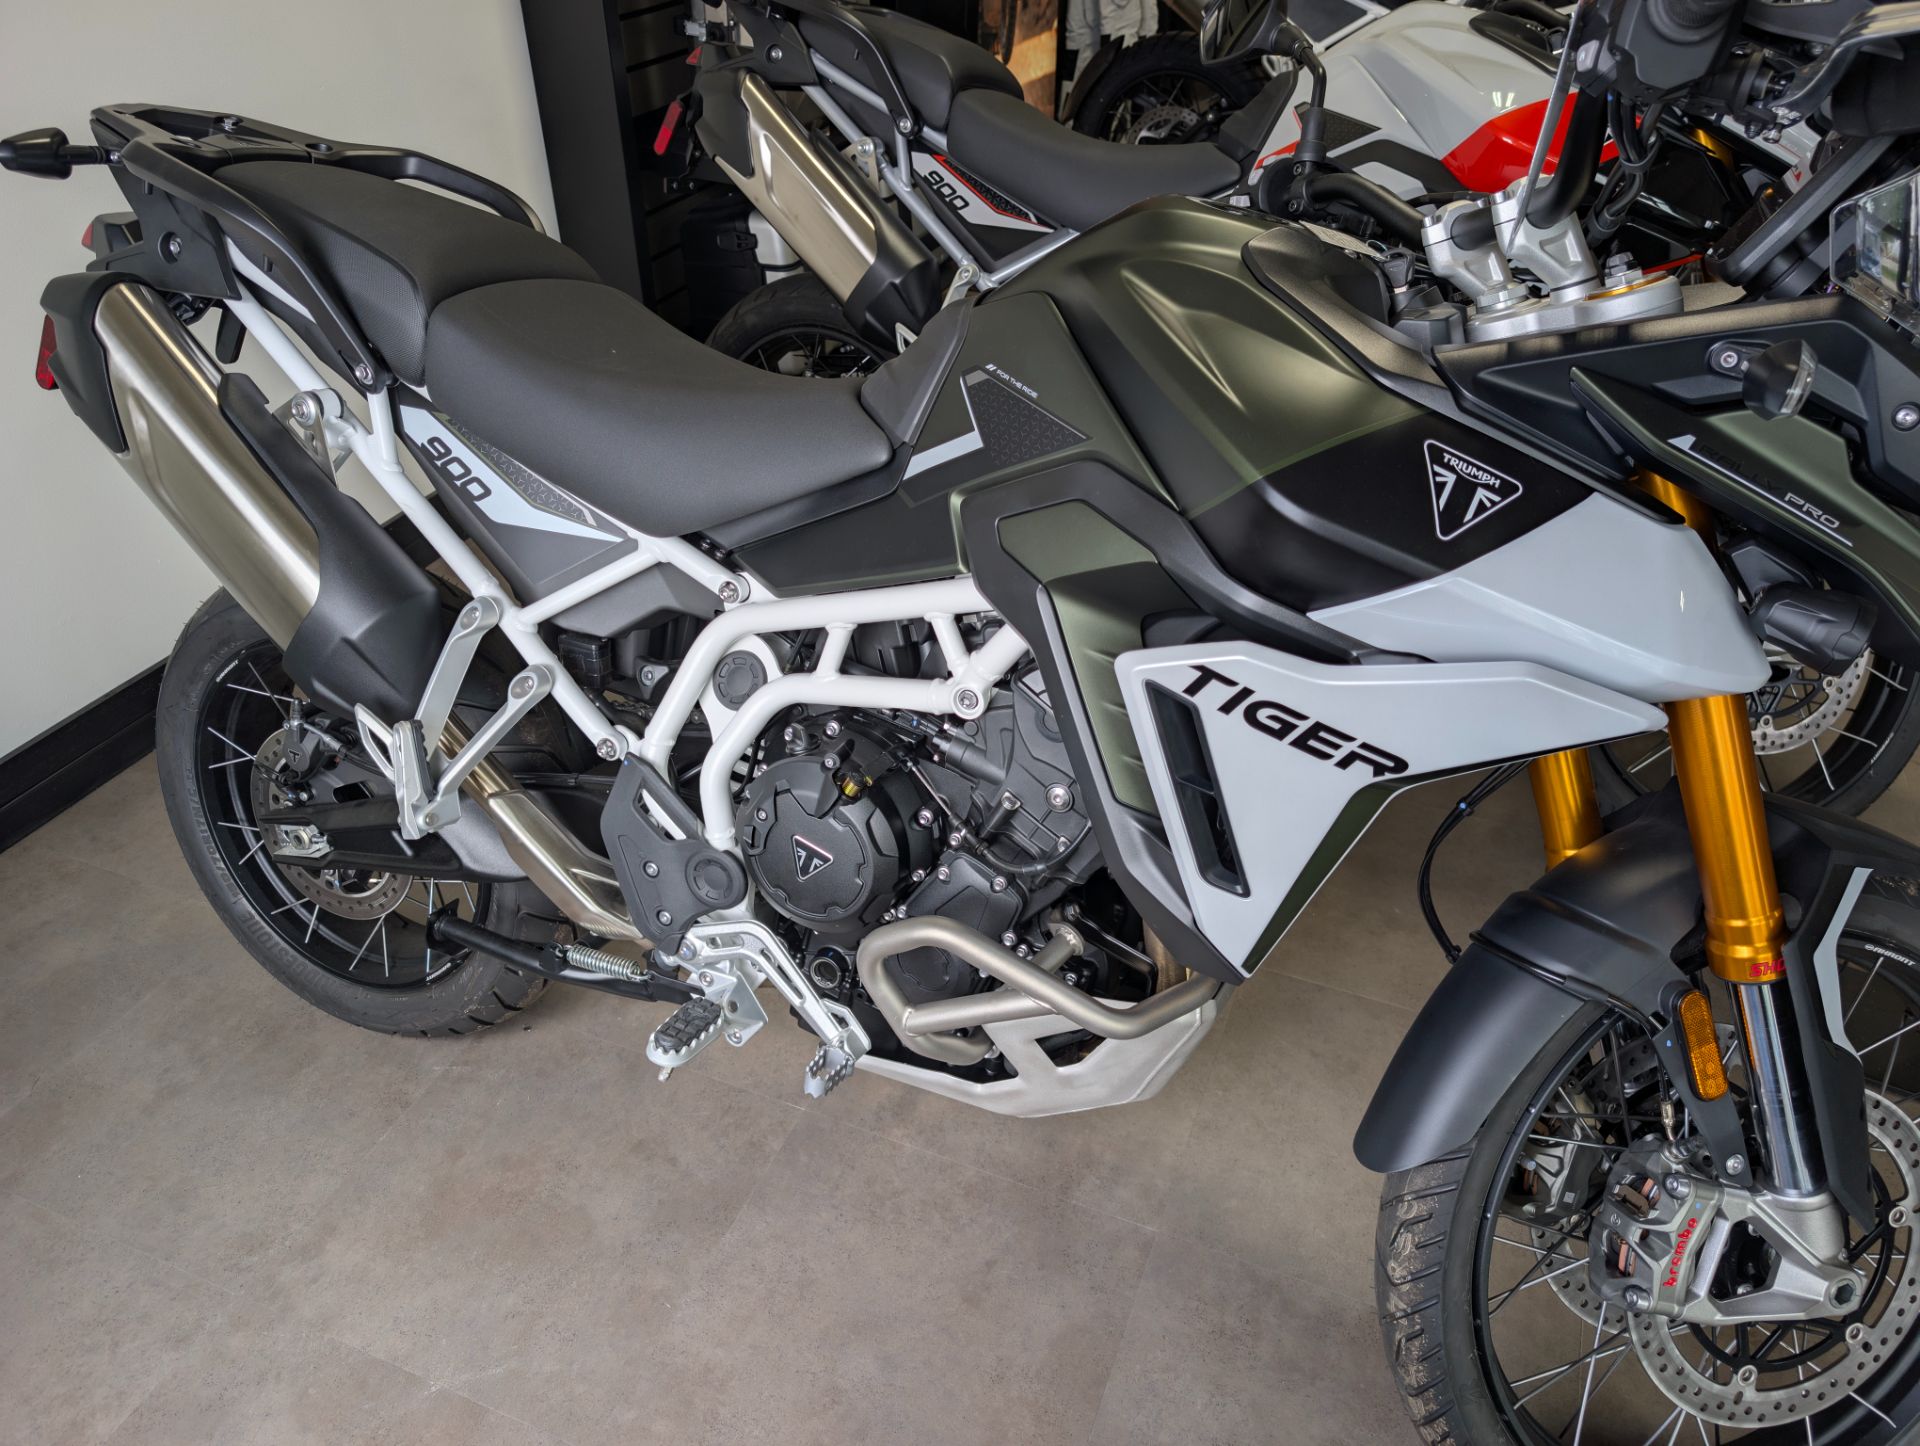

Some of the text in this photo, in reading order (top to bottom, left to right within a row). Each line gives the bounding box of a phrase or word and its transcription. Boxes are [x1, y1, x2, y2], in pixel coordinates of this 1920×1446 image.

[923, 170, 970, 211] 900
[996, 369, 1010, 381] FOR
[1010, 377, 1023, 390] THE
[420, 436, 492, 502] 900
[1443, 452, 1501, 489] TRIUMPH
[1783, 491, 1841, 530] PRO
[1182, 664, 1410, 778] TIGER
[1662, 1217, 1698, 1287] brembo
